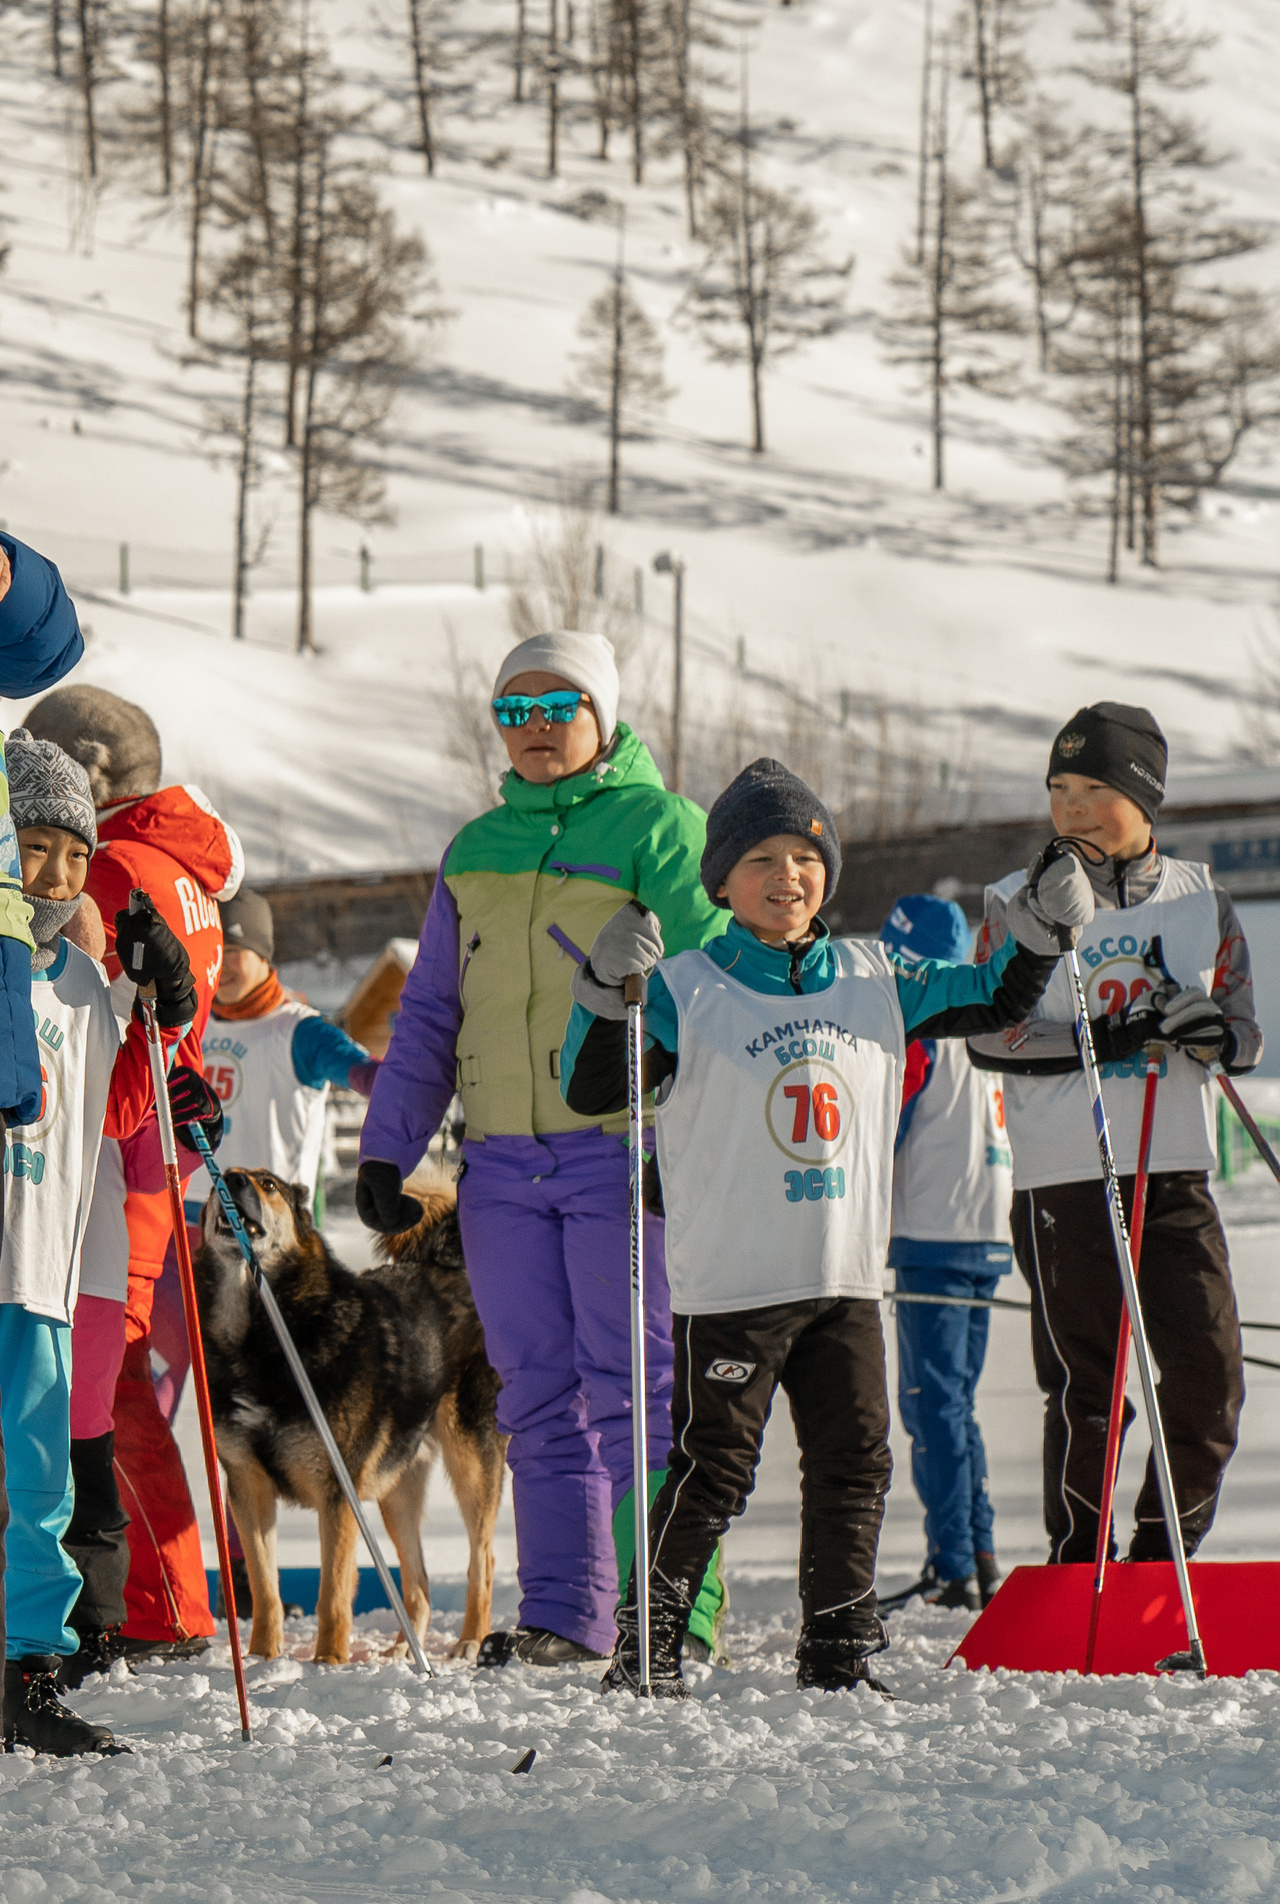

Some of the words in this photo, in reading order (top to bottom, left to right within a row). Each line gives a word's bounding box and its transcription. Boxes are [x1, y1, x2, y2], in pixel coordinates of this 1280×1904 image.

[744, 1019, 858, 1059] КАМЧАТКА
[774, 1038, 836, 1067] БСОШ
[783, 1082, 841, 1144] 76
